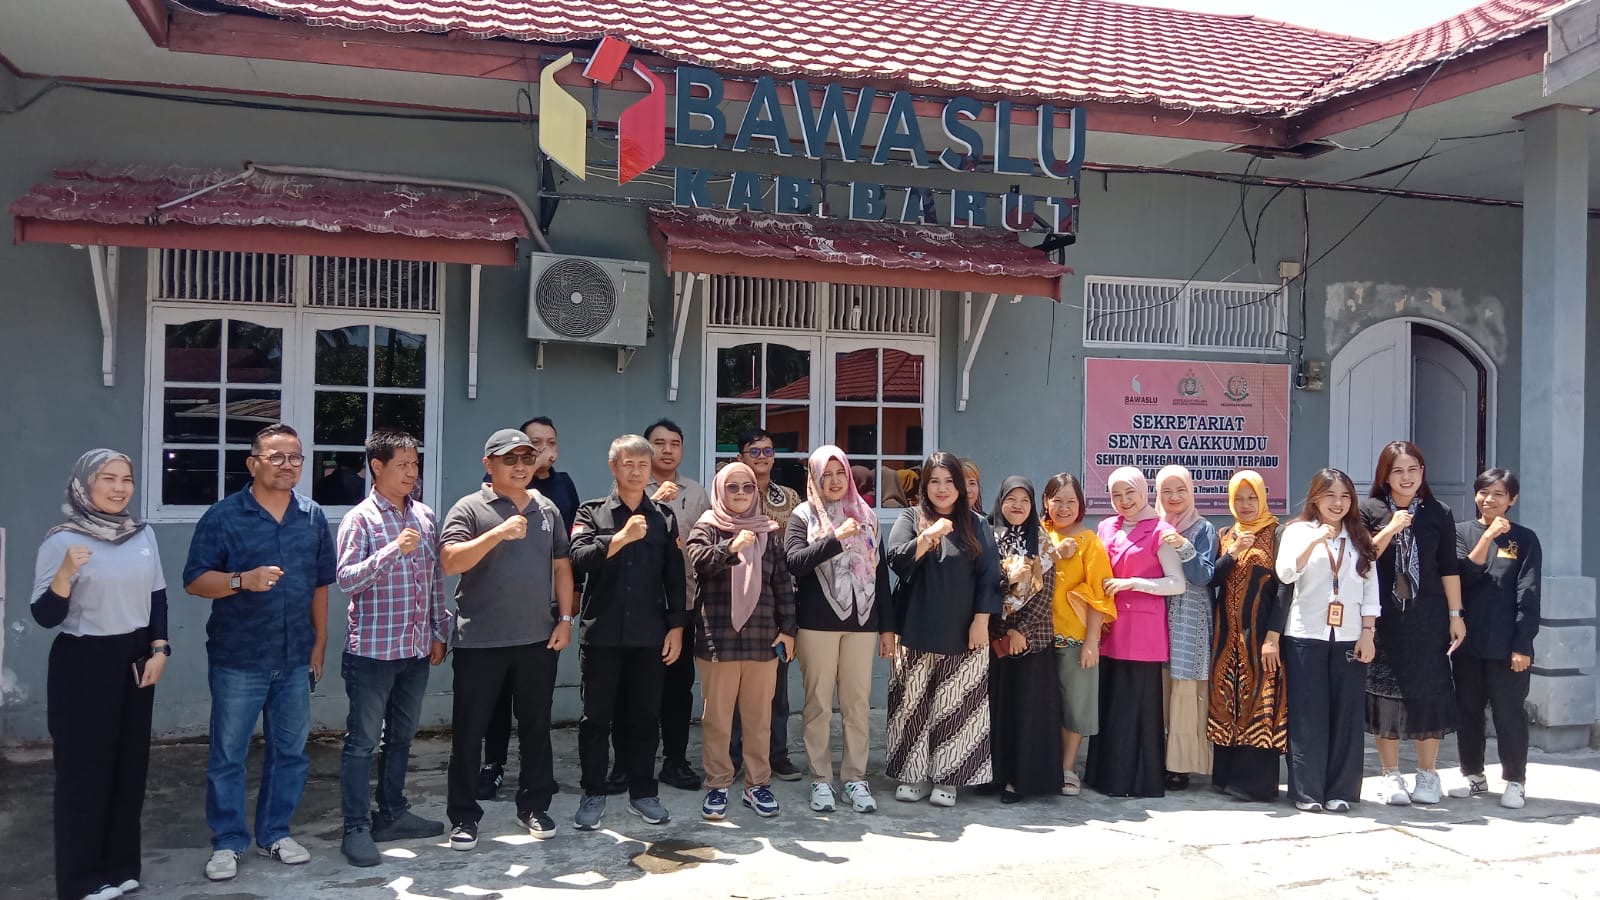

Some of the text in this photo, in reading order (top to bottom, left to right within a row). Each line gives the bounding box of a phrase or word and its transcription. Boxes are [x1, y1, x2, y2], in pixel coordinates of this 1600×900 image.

[675, 66, 1086, 180] BAWASLU
[849, 181, 1079, 235] BARUT
[1132, 415, 1245, 431] SEKRETARIAT
[1108, 434, 1267, 451] SENTRA GAKKUMDU
[1096, 453, 1278, 468] SENTRA PENEGAKKAN HUKUM TERPADU
[1198, 485, 1218, 494] Teweh
